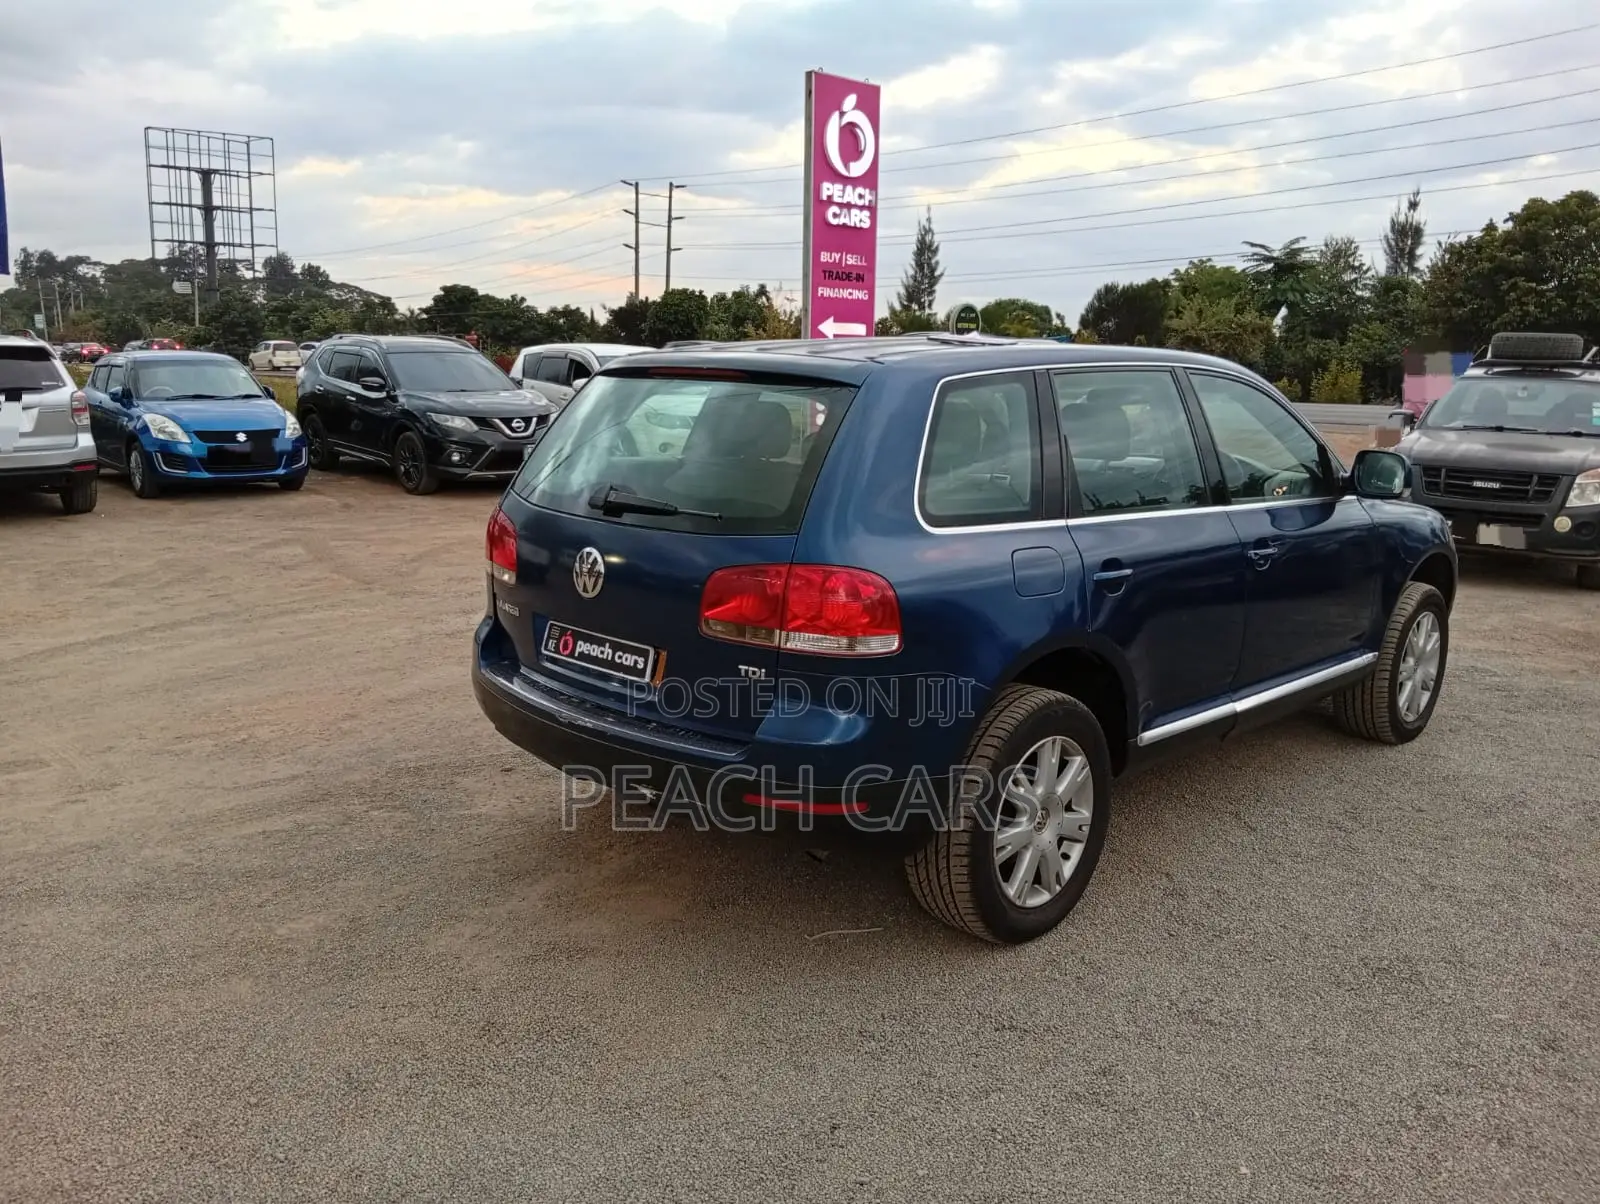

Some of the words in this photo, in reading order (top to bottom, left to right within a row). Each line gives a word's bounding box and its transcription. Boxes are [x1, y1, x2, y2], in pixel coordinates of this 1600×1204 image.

[820, 181, 876, 207] PEACH
[825, 205, 871, 229] CARS
[820, 251, 841, 263] BUY
[846, 254, 868, 266] SELL
[822, 269, 865, 283] TRADE-IN
[817, 286, 869, 301] FINANCING
[1472, 480, 1500, 489] ISUZU
[574, 640, 612, 660] peach
[614, 651, 645, 669] cars
